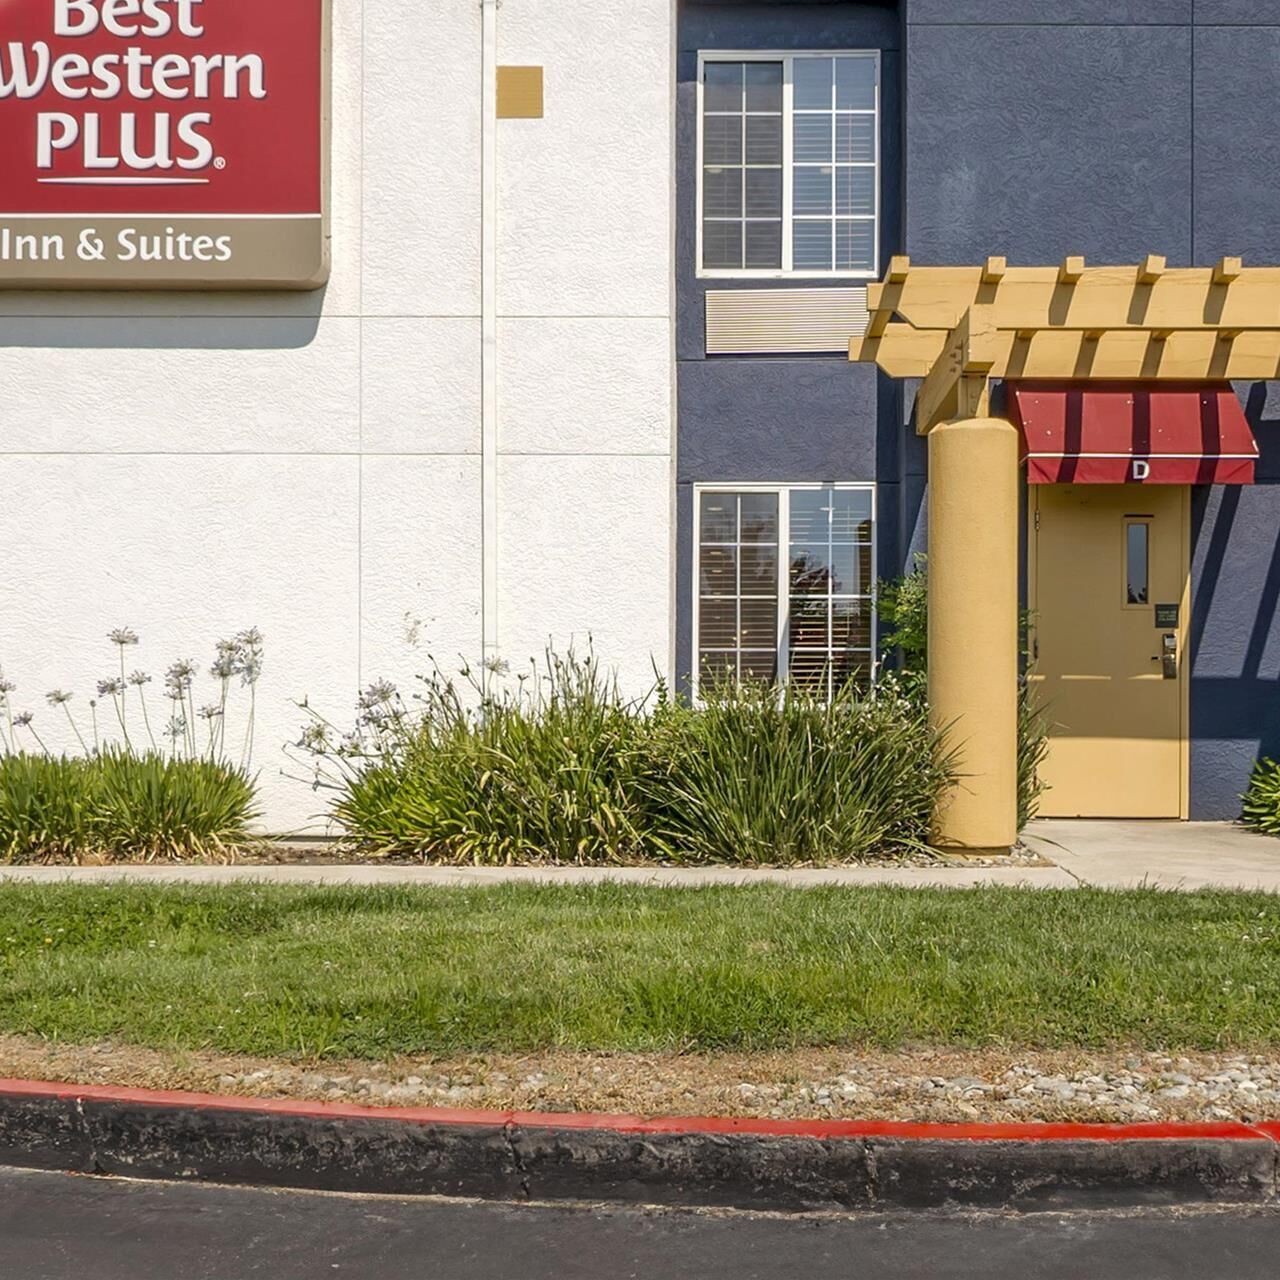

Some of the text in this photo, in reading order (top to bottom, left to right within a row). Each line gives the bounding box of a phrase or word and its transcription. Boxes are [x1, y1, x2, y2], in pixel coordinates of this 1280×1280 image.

[1, 228, 65, 261] Inn
[76, 228, 106, 261] &
[116, 226, 232, 262] Suites
[1132, 460, 1151, 480] D
